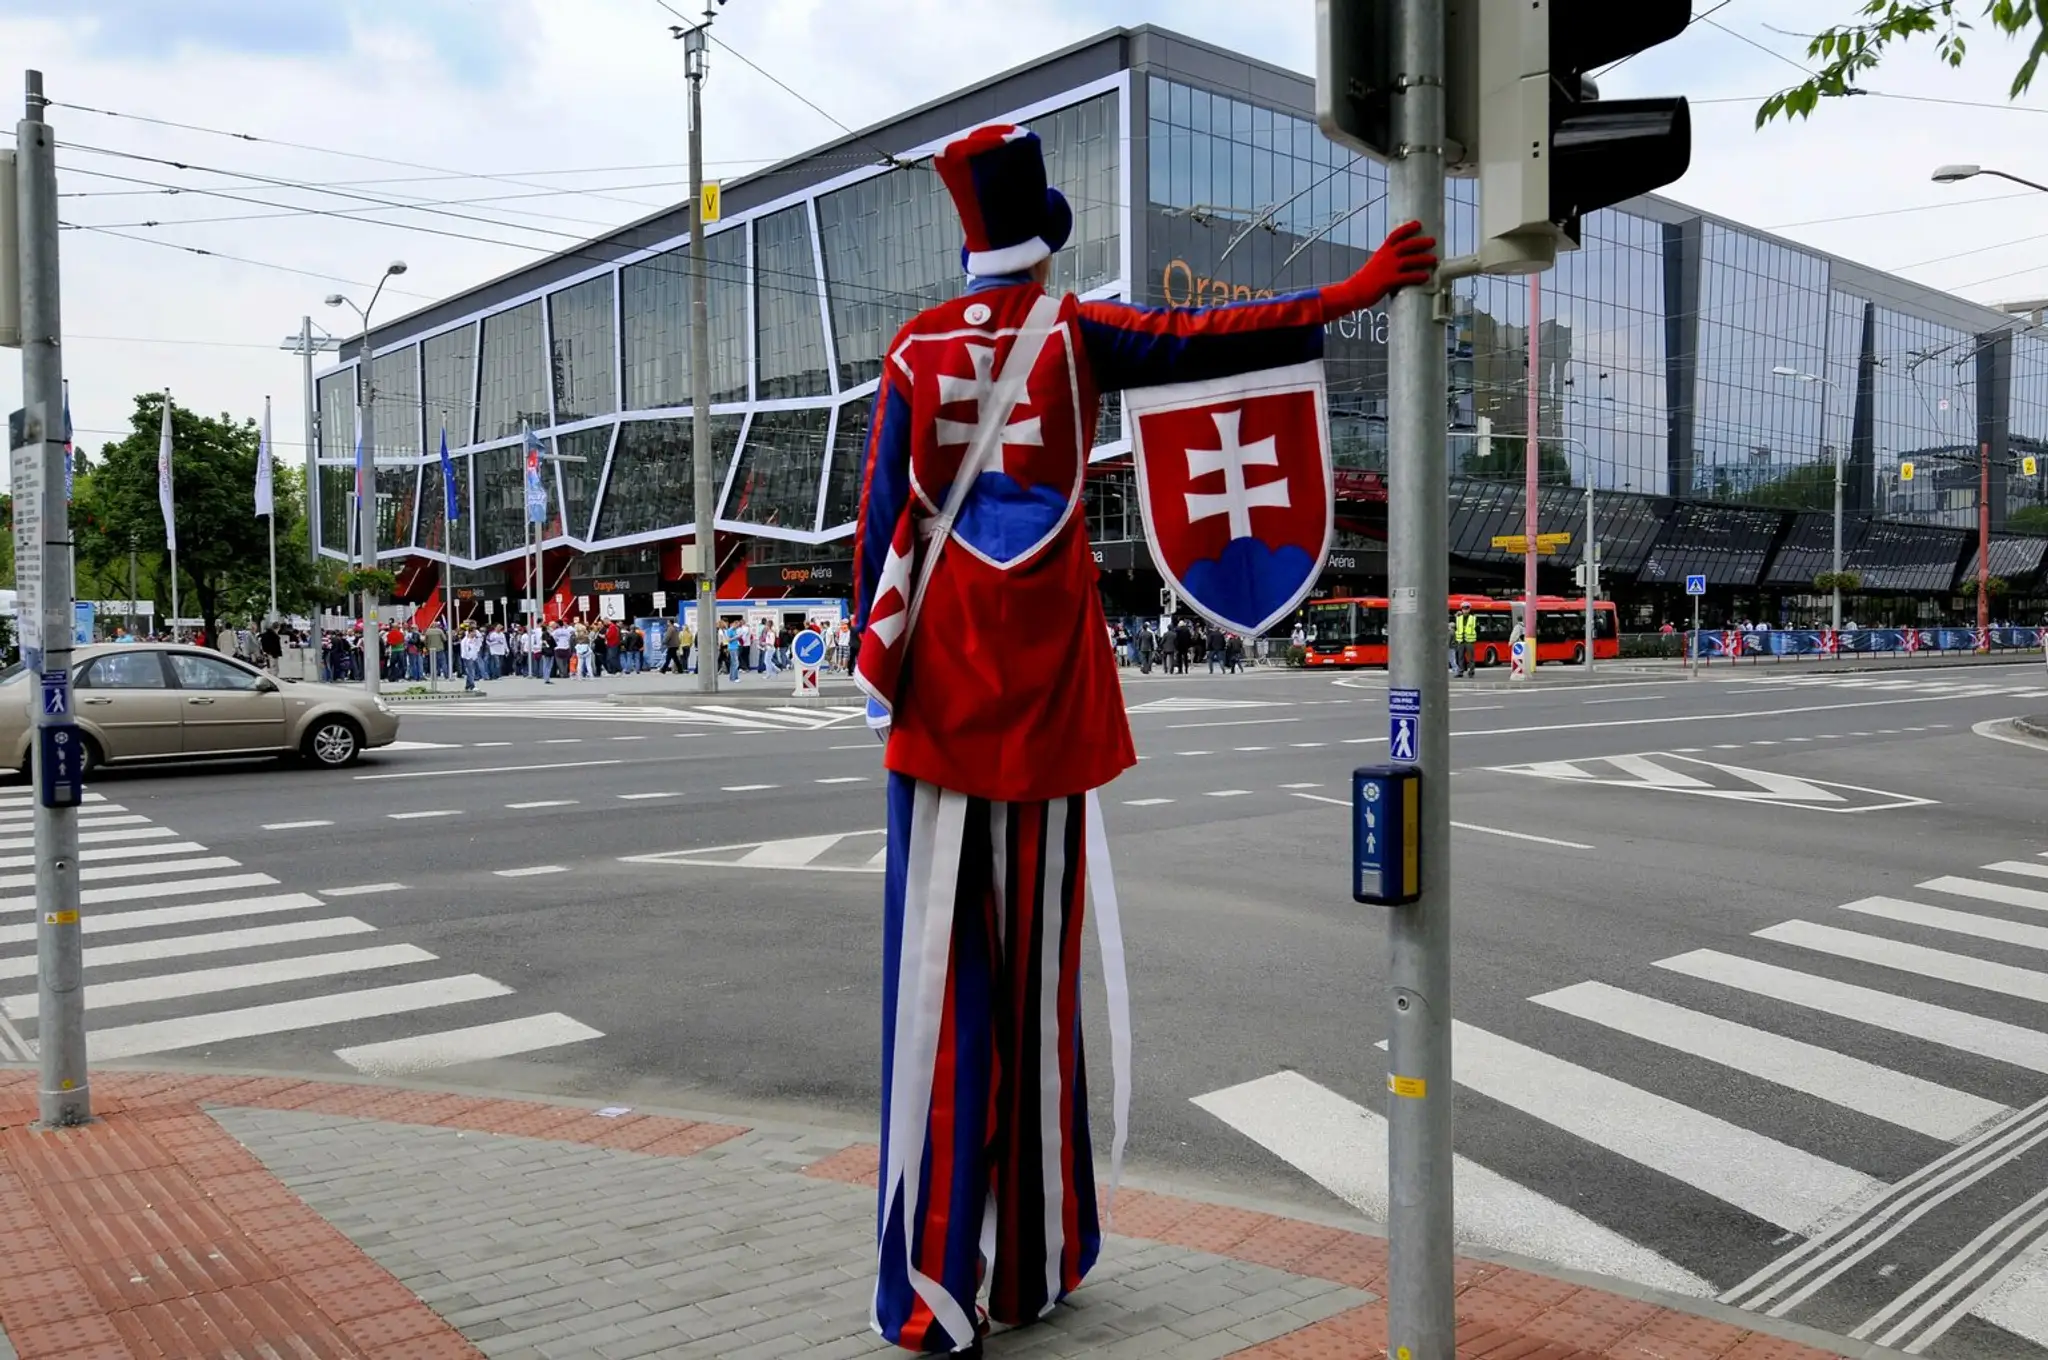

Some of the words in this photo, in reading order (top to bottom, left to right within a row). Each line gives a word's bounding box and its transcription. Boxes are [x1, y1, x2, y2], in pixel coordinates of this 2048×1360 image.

[705, 193, 715, 212] V
[1328, 554, 1356, 568] Aréna
[781, 567, 810, 582] Orange
[810, 565, 832, 579] Aréna
[593, 580, 616, 592] Orange
